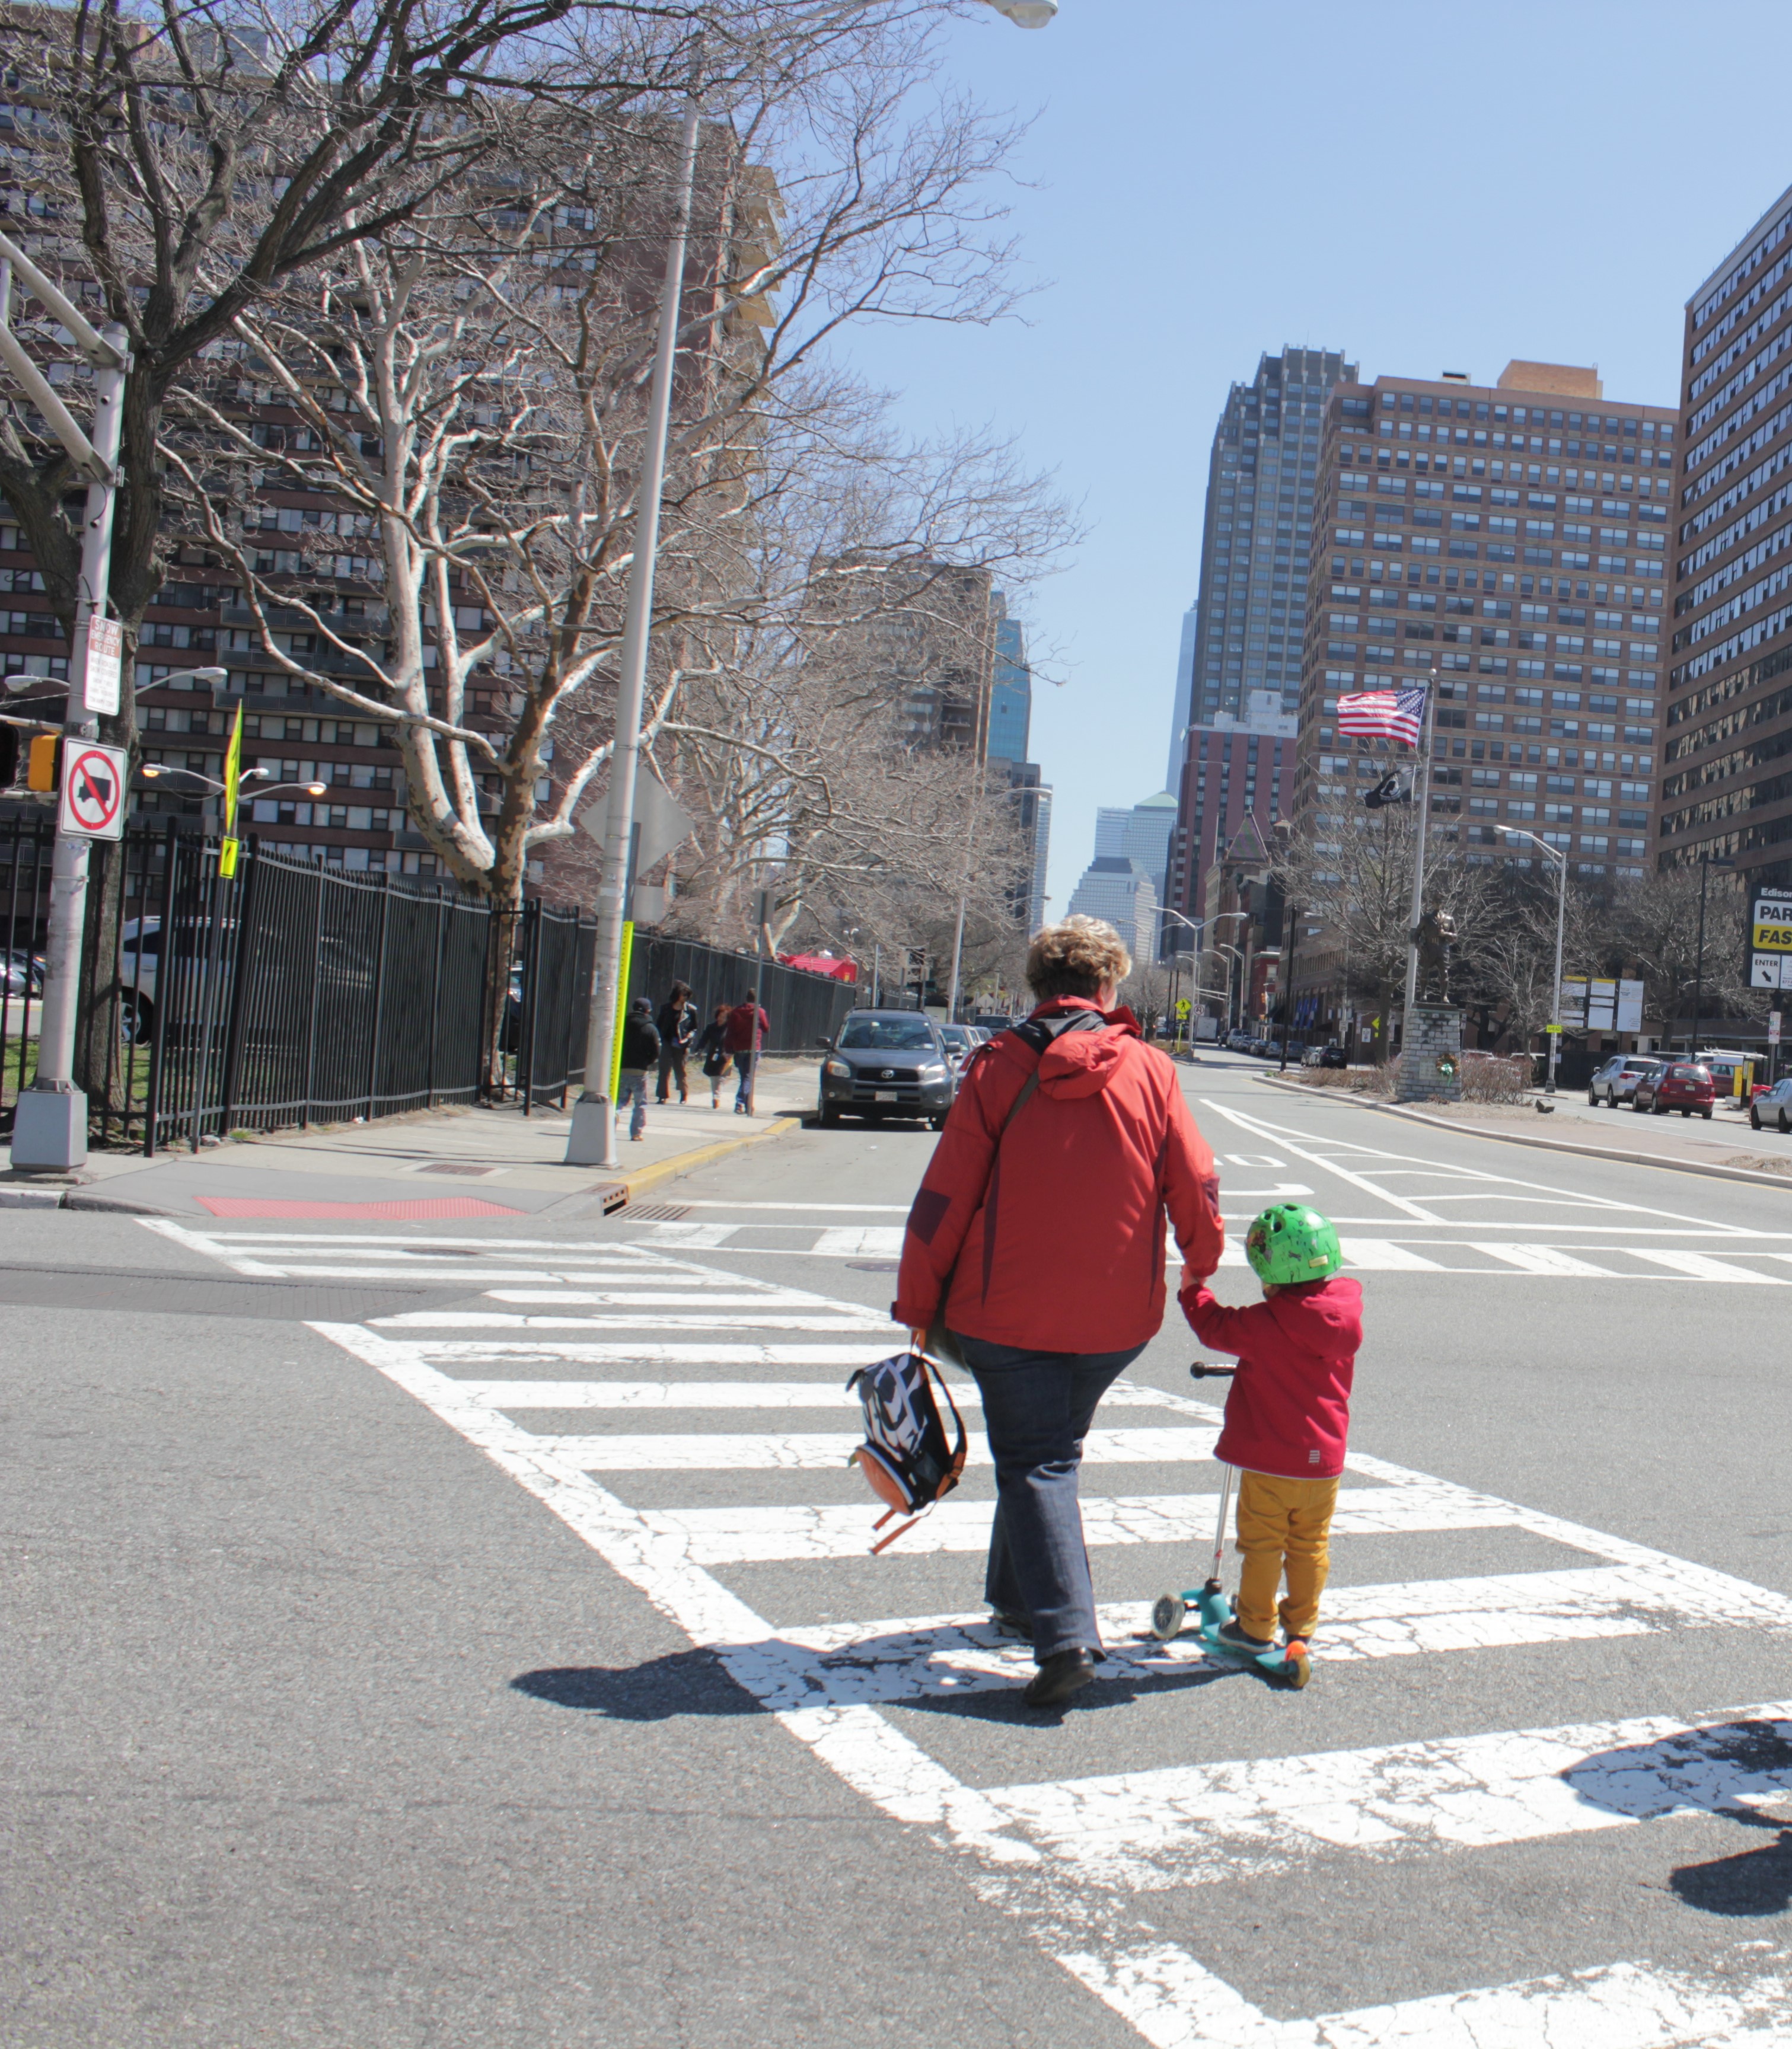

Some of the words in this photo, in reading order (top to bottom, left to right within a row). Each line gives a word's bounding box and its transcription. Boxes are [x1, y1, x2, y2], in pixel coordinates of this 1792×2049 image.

[94, 619, 119, 636] SNOW
[91, 629, 120, 647] EMERGENCY
[94, 641, 116, 656] ROUTE
[1760, 905, 1792, 921] PAR
[1758, 928, 1792, 945] FAS
[1755, 959, 1779, 967] ENTER
